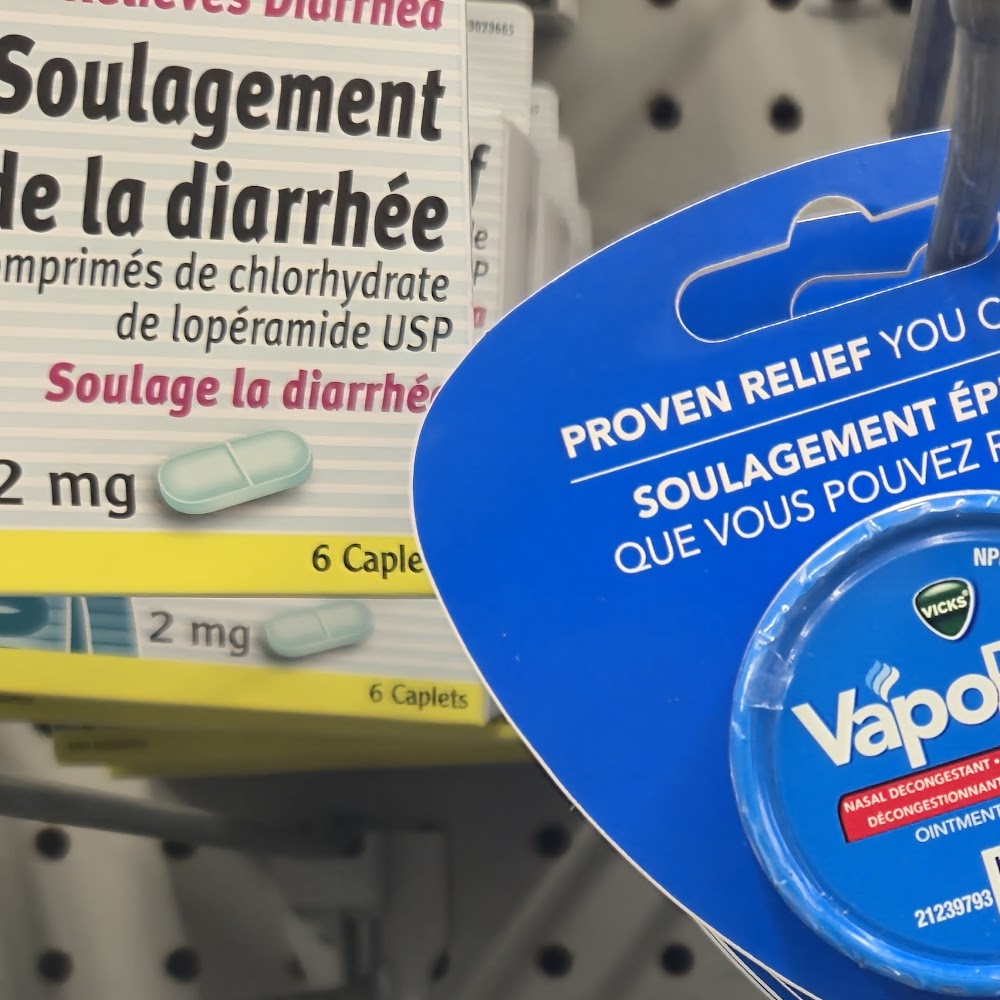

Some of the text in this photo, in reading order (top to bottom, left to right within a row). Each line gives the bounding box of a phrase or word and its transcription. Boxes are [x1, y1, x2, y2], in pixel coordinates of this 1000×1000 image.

[0, 33, 444, 150] Soulagement
[82, 155, 144, 237] la
[167, 161, 449, 252] diarrhée
[0, 246, 163, 295] mprimés
[175, 251, 218, 291] de
[229, 254, 450, 307] chlorhydrate
[116, 301, 160, 342] de
[172, 303, 370, 353] lopéramide
[383, 311, 453, 353] USP
[45, 362, 221, 418] Soulage
[232, 367, 272, 409] la
[560, 378, 731, 459] PROVEN
[740, 336, 873, 406] RELIEF
[879, 307, 966, 361] YOU
[633, 397, 937, 519] SOULAGEMENT
[0, 458, 136, 519] 2 mg
[613, 521, 701, 575] QUE
[704, 488, 815, 547] VOUS
[825, 444, 981, 515] POUVEZ
[312, 543, 424, 579] 6 Caple
[149, 611, 252, 656] 2 mg
[369, 683, 469, 711] 6 Caplets
[843, 792, 888, 813] NASAL
[888, 758, 991, 799] DECONGESTANT
[913, 889, 994, 928] 21239793
